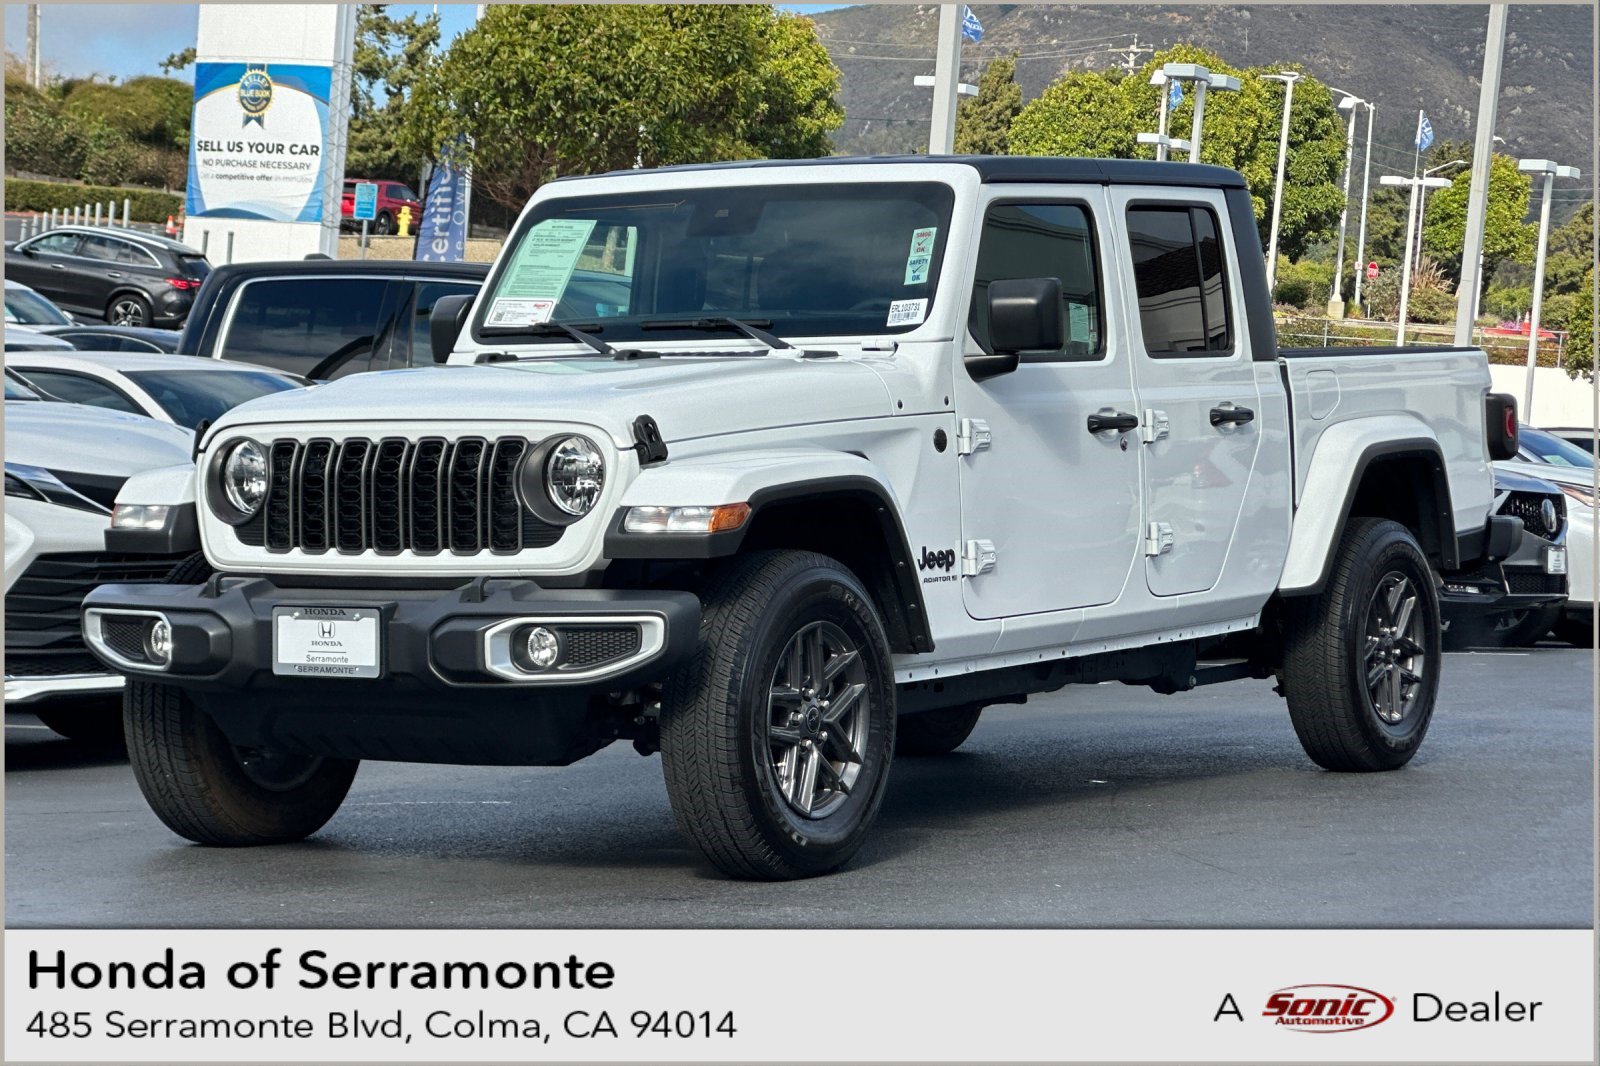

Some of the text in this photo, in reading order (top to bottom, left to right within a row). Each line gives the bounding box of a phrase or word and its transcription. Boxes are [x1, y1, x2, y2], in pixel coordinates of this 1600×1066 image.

[197, 140, 320, 156] SELL US YOUR CAR
[202, 158, 311, 170] NO PURCHASE NECESSARY
[215, 172, 255, 182] competitive
[256, 173, 273, 182] offer
[909, 258, 928, 266] SAFETY
[911, 274, 921, 282] OK
[917, 545, 956, 572] Jeep
[304, 608, 347, 616] HONDA
[305, 654, 349, 664] Serramonte
[297, 665, 354, 674] SERRAMONTE
